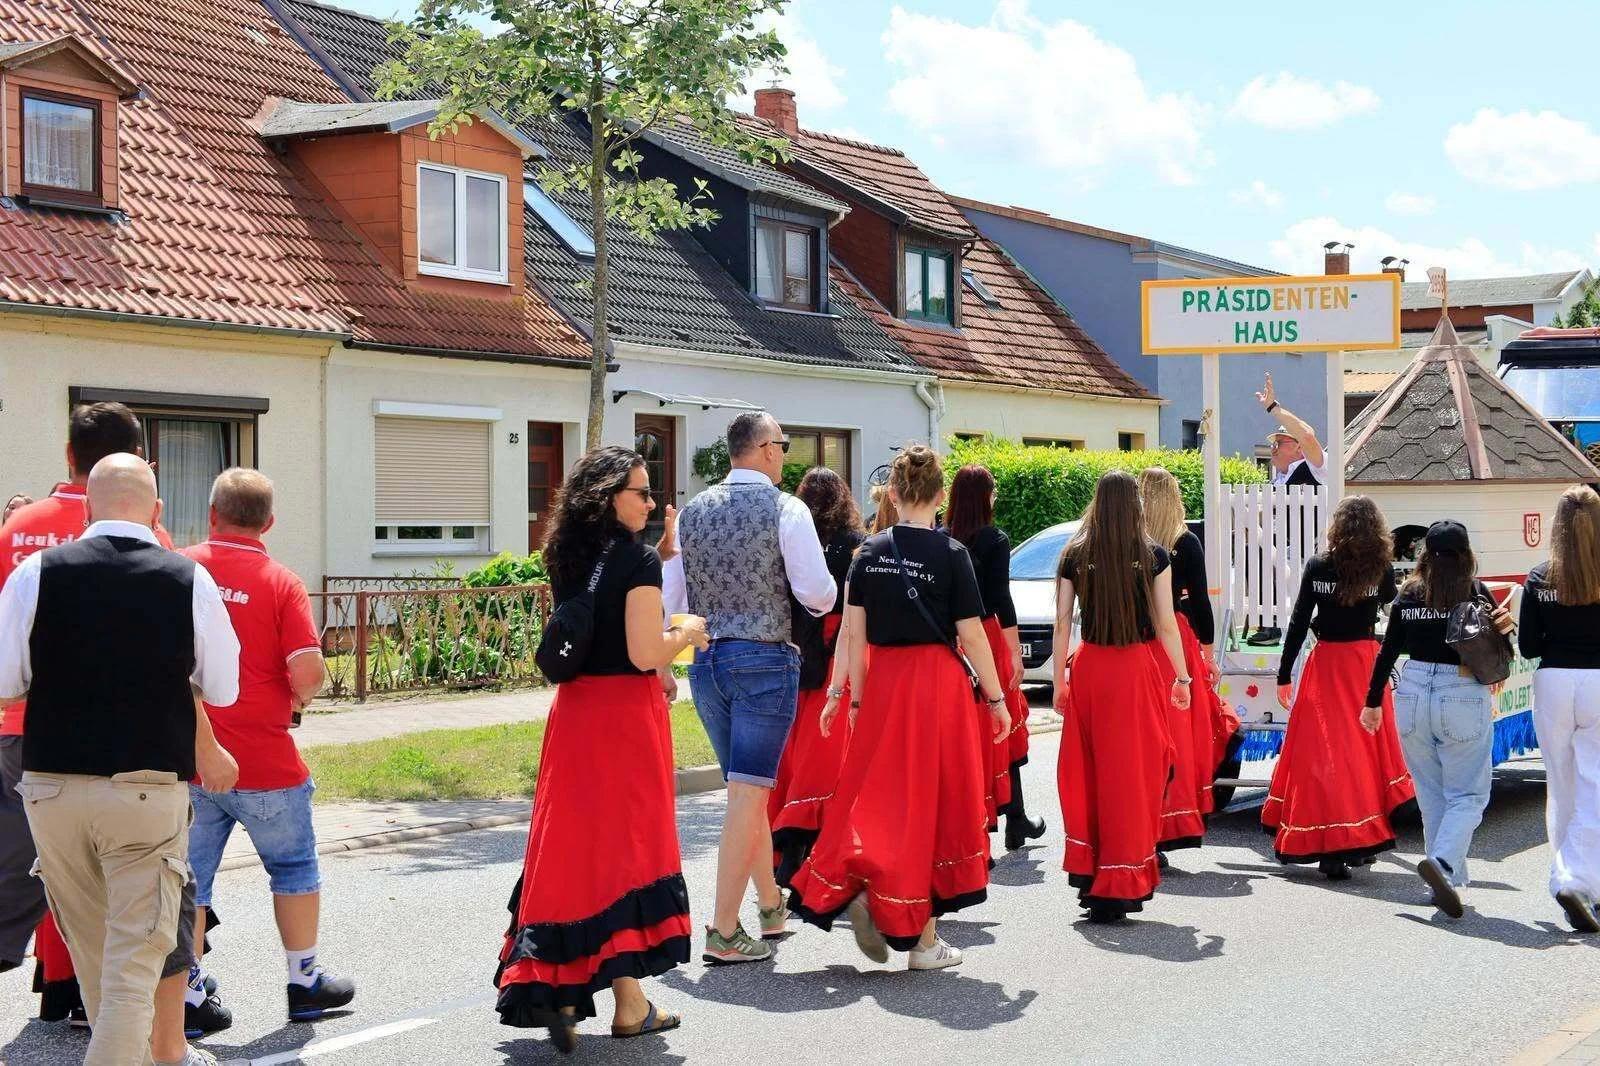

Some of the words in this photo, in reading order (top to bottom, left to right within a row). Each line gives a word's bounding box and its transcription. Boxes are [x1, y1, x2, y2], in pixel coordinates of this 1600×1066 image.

[1182, 286, 1358, 313] PRÄSIDENTEN-
[1234, 320, 1298, 344] HAUS
[509, 432, 519, 444] 25
[919, 572, 935, 584] e.V.
[1514, 684, 1531, 710] LEBT
